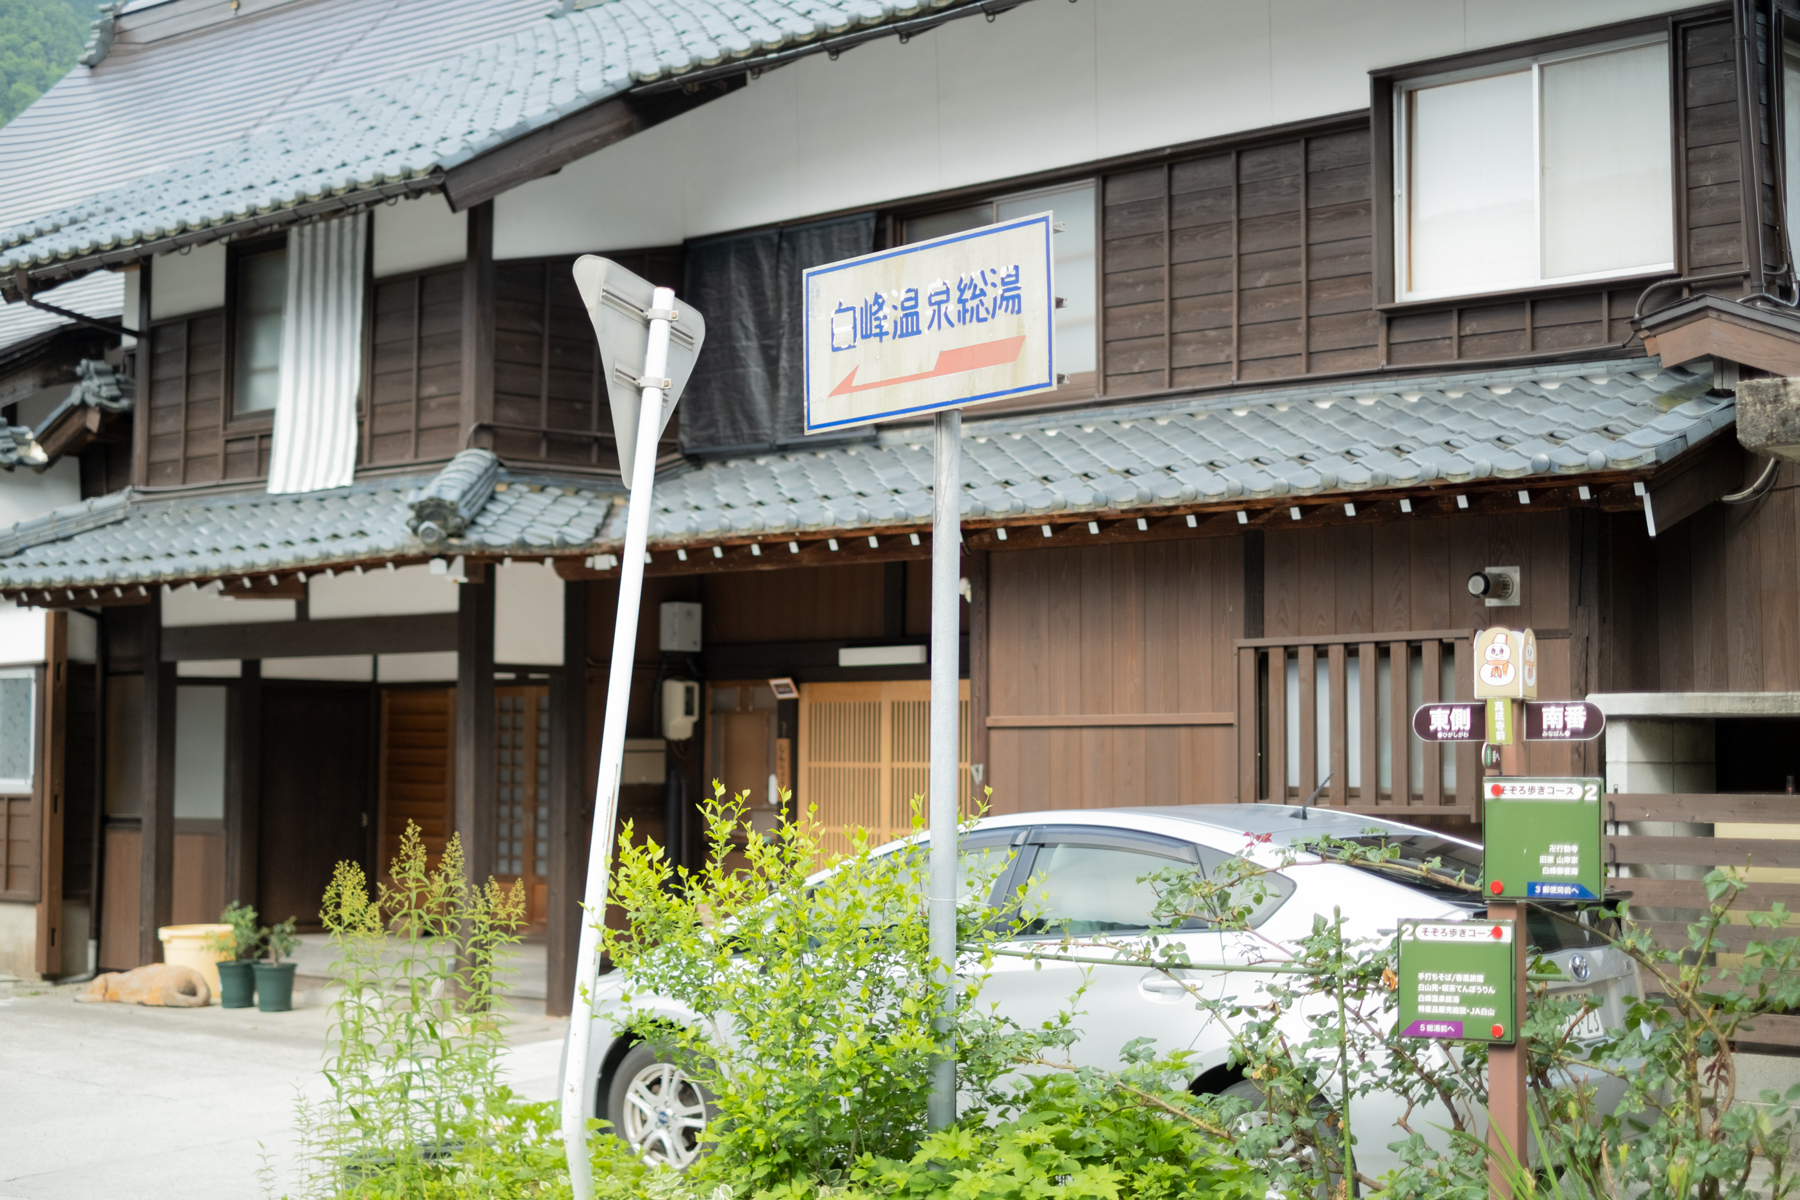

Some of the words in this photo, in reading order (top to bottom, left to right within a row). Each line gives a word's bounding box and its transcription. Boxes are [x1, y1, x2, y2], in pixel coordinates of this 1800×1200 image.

[831, 264, 1022, 352] 白峰温泉総湯
[1429, 708, 1471, 731] 東側
[1542, 706, 1587, 729] 南番
[1583, 784, 1598, 800] 2
[1401, 924, 1414, 940] 2
[1420, 1024, 1426, 1032] 5
